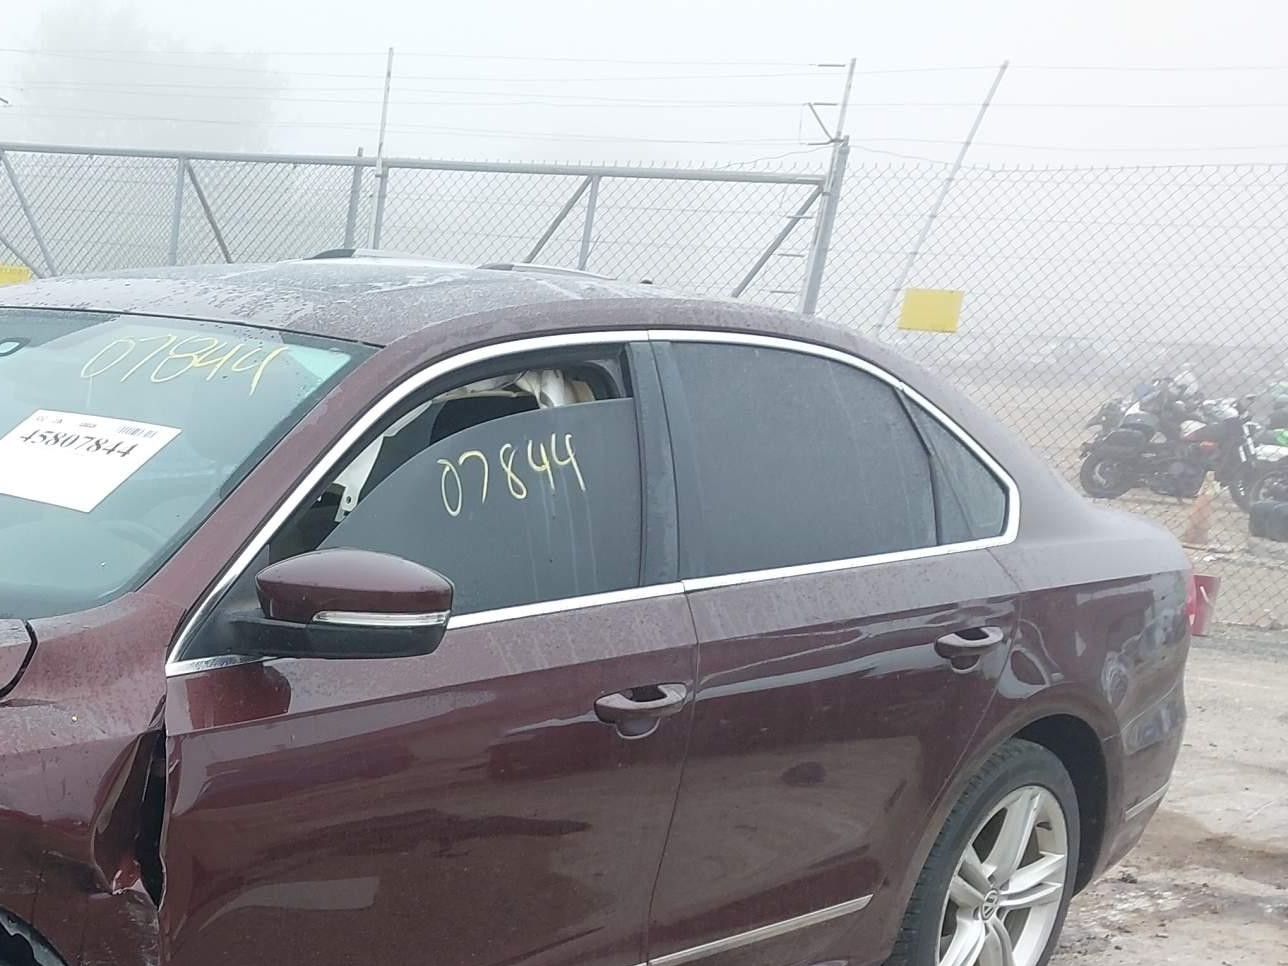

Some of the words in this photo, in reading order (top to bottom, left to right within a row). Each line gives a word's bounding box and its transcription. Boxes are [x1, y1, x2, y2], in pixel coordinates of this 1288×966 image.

[81, 334, 289, 396] 07844
[20, 428, 139, 458] 45807844
[437, 433, 586, 517] 07844
